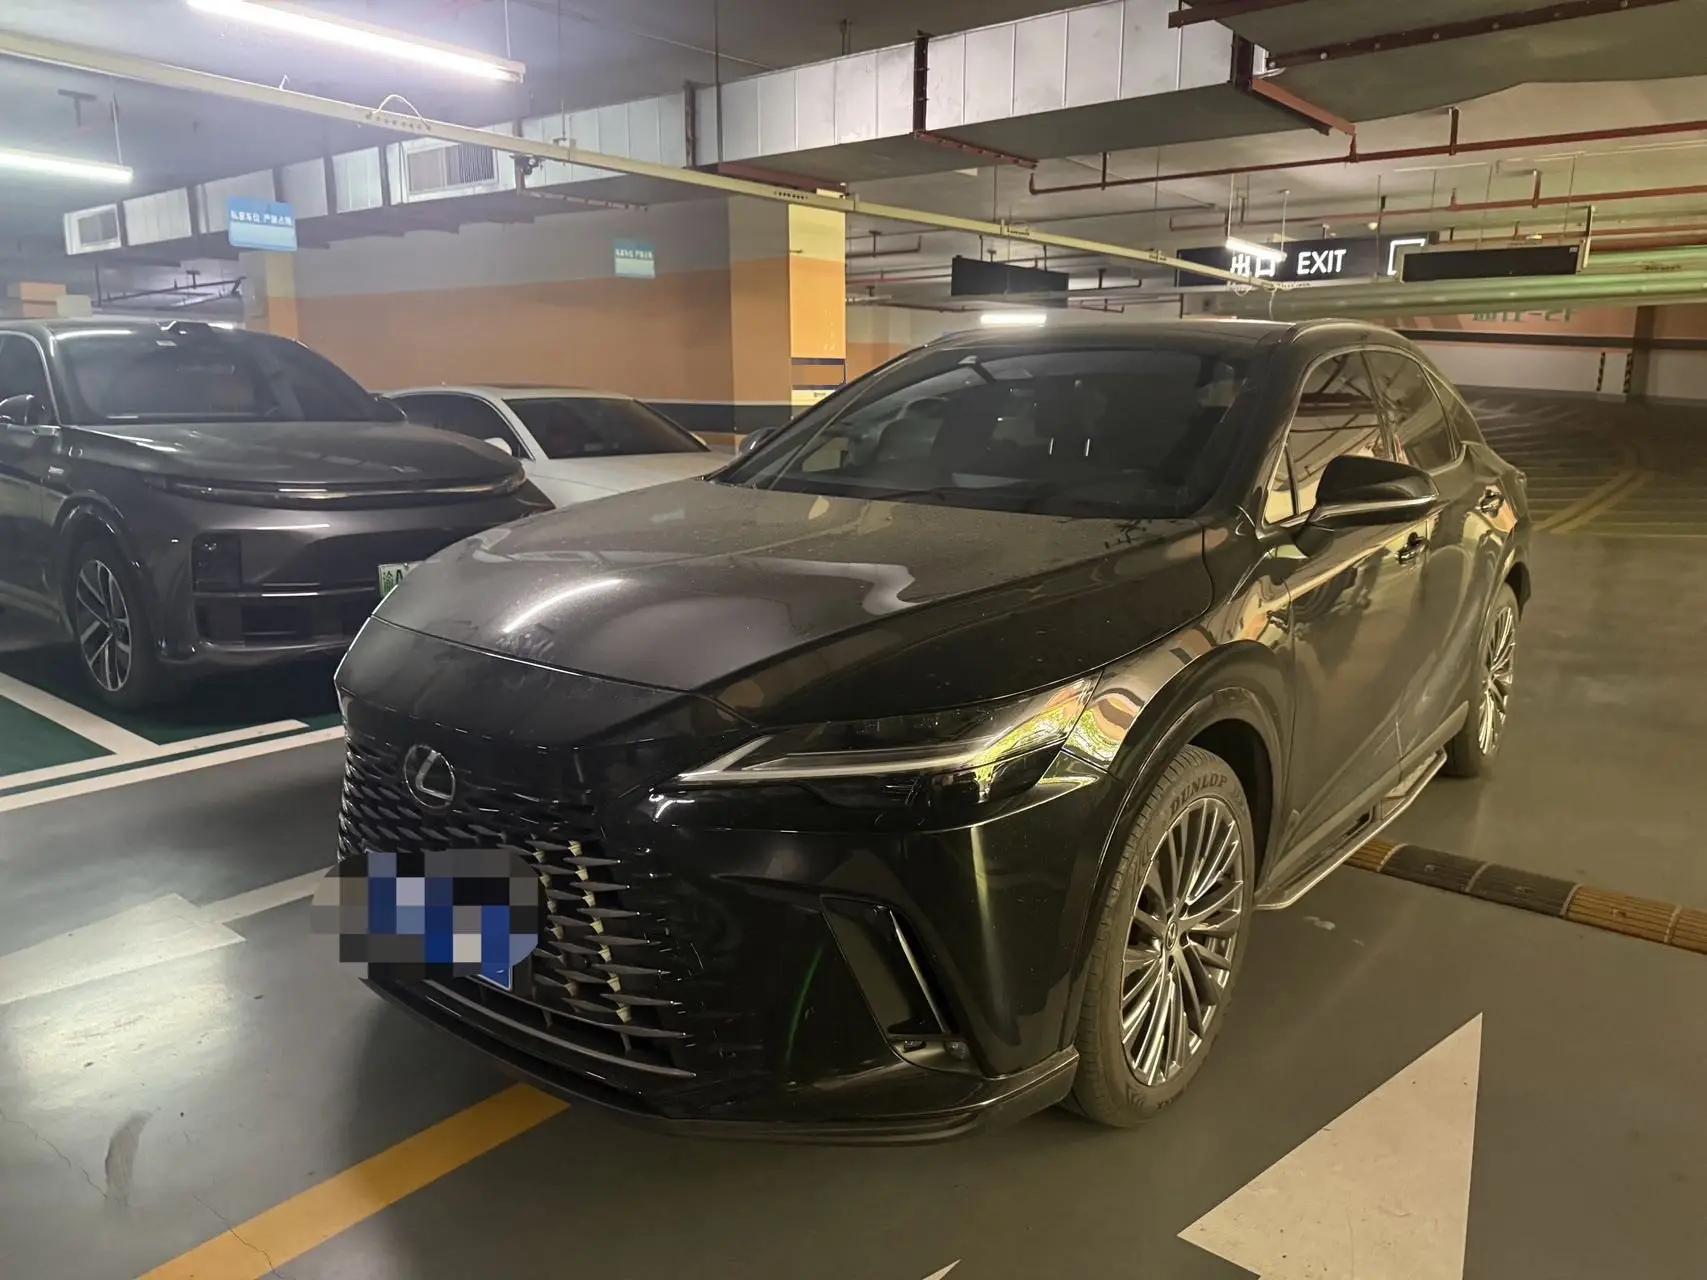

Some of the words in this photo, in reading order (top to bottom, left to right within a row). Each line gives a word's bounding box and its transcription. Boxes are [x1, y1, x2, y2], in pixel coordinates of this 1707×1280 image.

[1230, 253, 1276, 278] 出口
[1297, 249, 1347, 274] EXIT
[1169, 773, 1228, 817] DUNLOP
